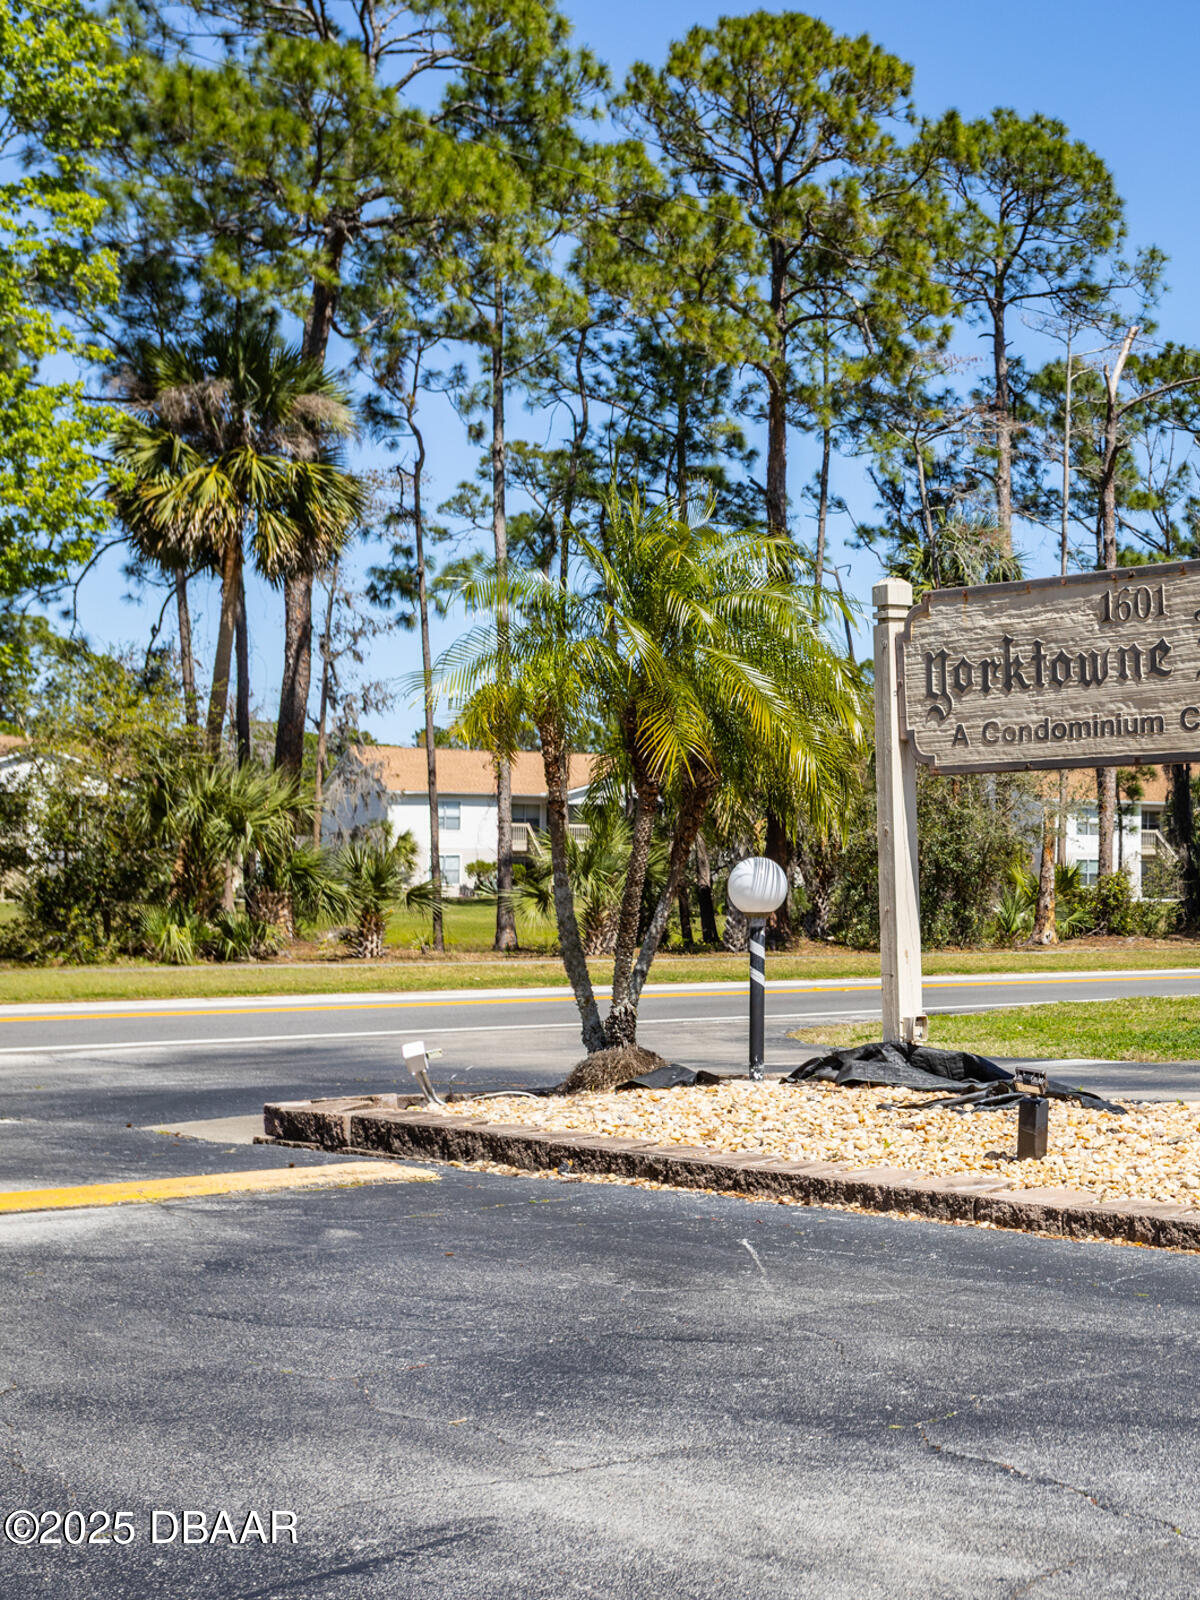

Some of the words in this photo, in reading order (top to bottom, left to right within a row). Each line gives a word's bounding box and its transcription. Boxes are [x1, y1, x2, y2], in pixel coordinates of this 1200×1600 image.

[1100, 583, 1170, 624] 1601
[924, 634, 1174, 723] Yorktowne
[952, 722, 971, 748] A
[981, 713, 1165, 745] Condominium
